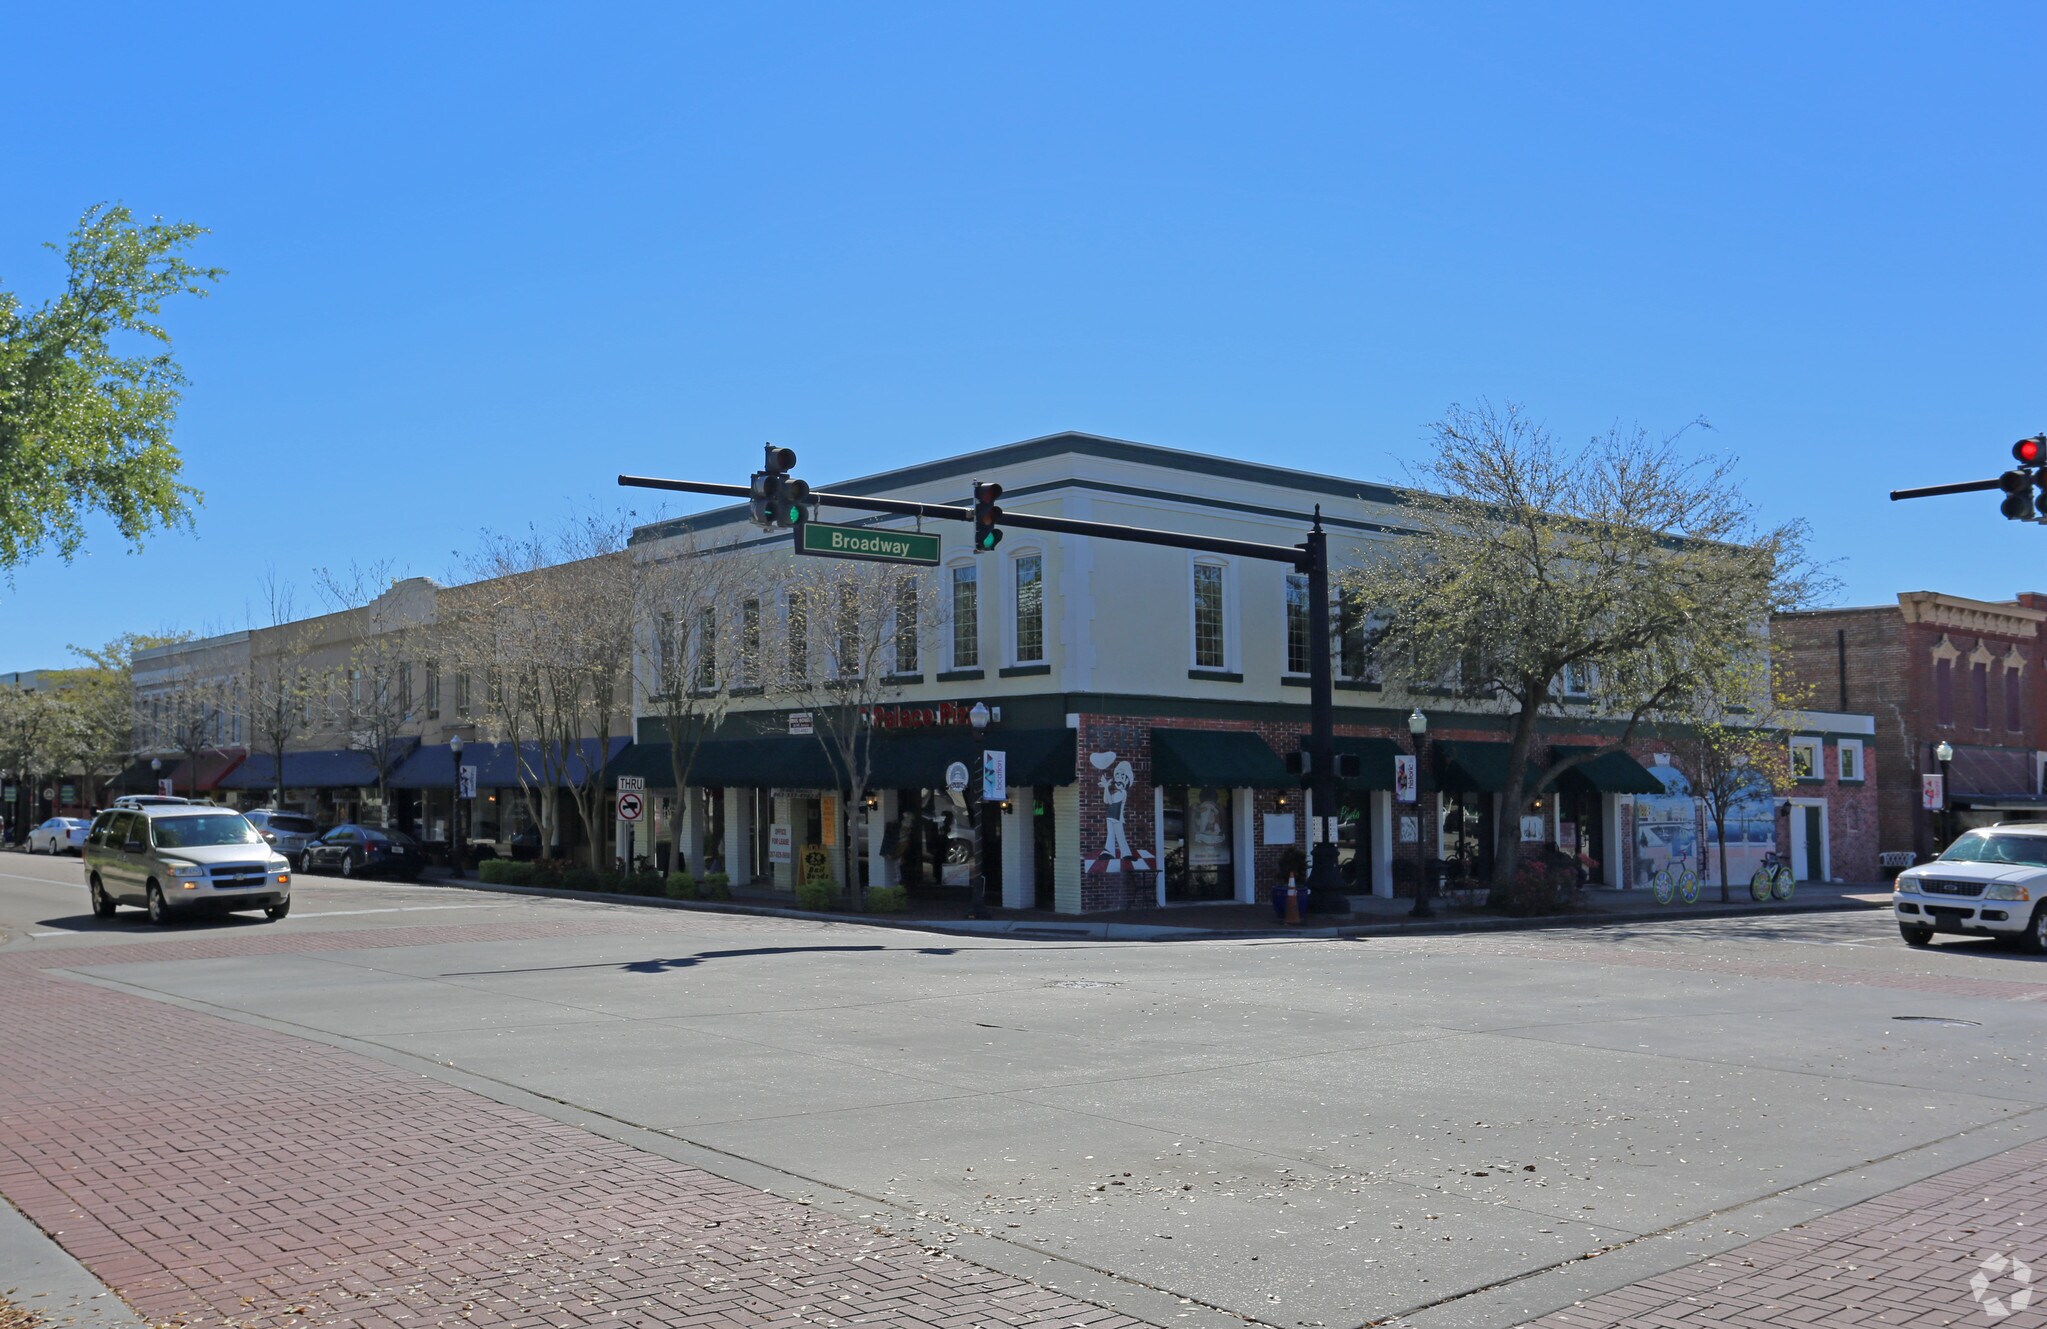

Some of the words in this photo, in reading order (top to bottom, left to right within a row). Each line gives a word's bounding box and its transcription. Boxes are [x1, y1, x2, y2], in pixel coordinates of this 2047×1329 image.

[832, 532, 909, 557] Broadway
[873, 705, 934, 729] Palace
[620, 778, 643, 790] THRU
[995, 760, 1003, 791] location
